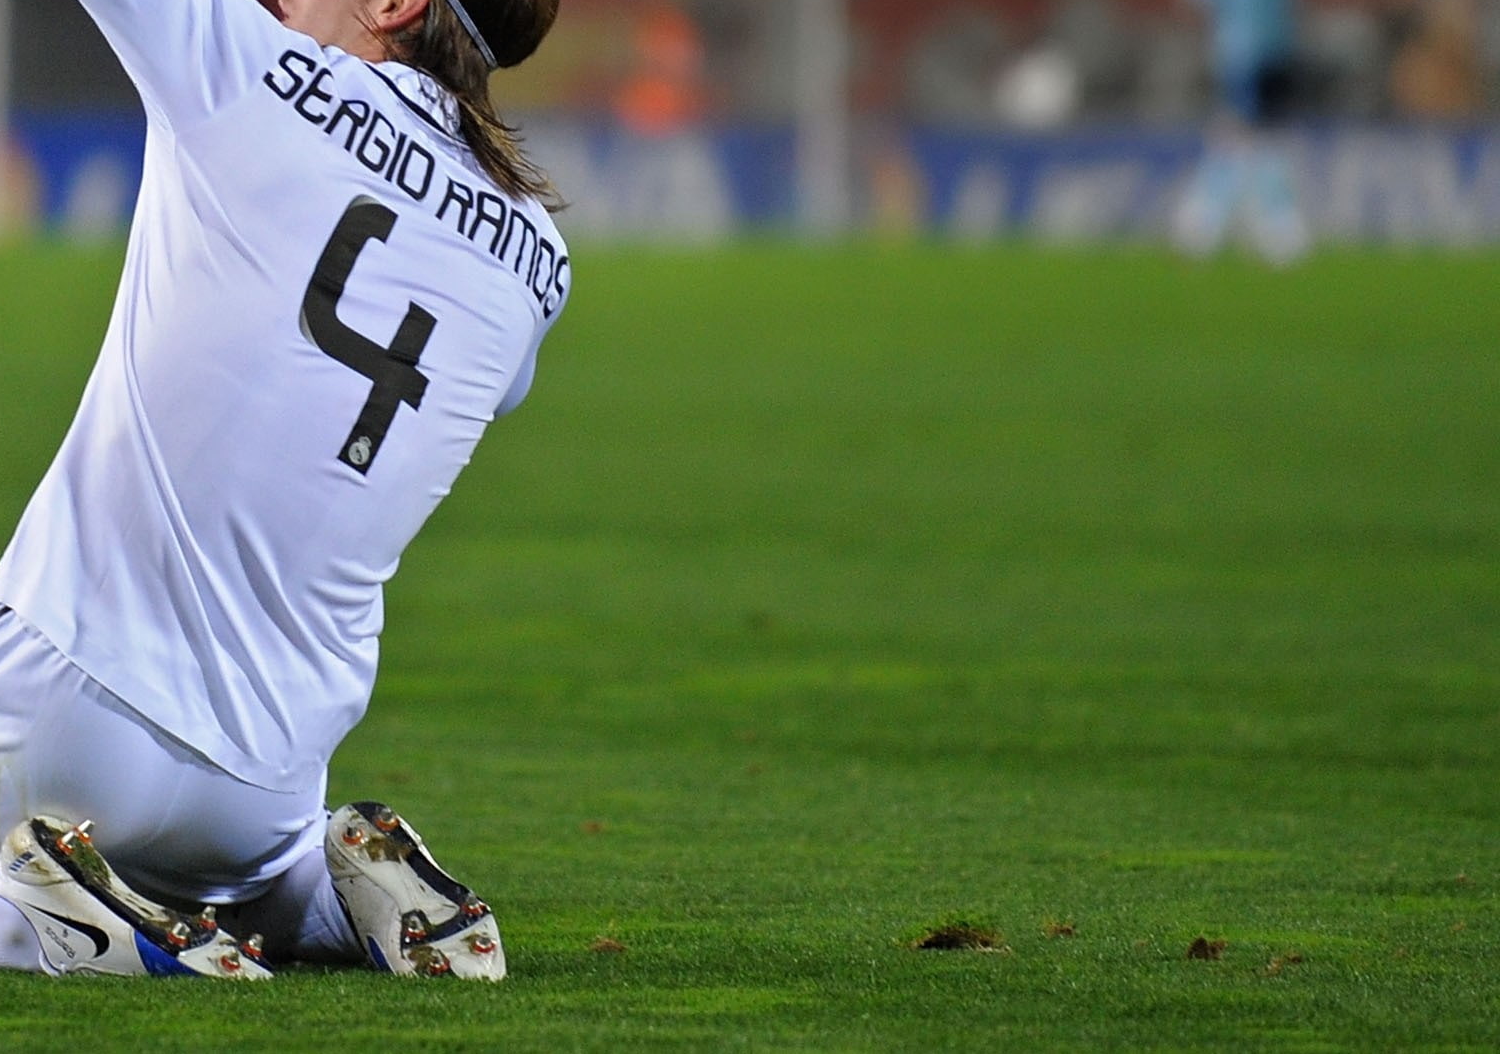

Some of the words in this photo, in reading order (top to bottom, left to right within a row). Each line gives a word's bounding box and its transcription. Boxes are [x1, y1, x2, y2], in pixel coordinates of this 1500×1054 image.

[263, 49, 436, 202] SERGIO
[435, 175, 570, 320] RAMOS
[298, 193, 438, 477] 4
